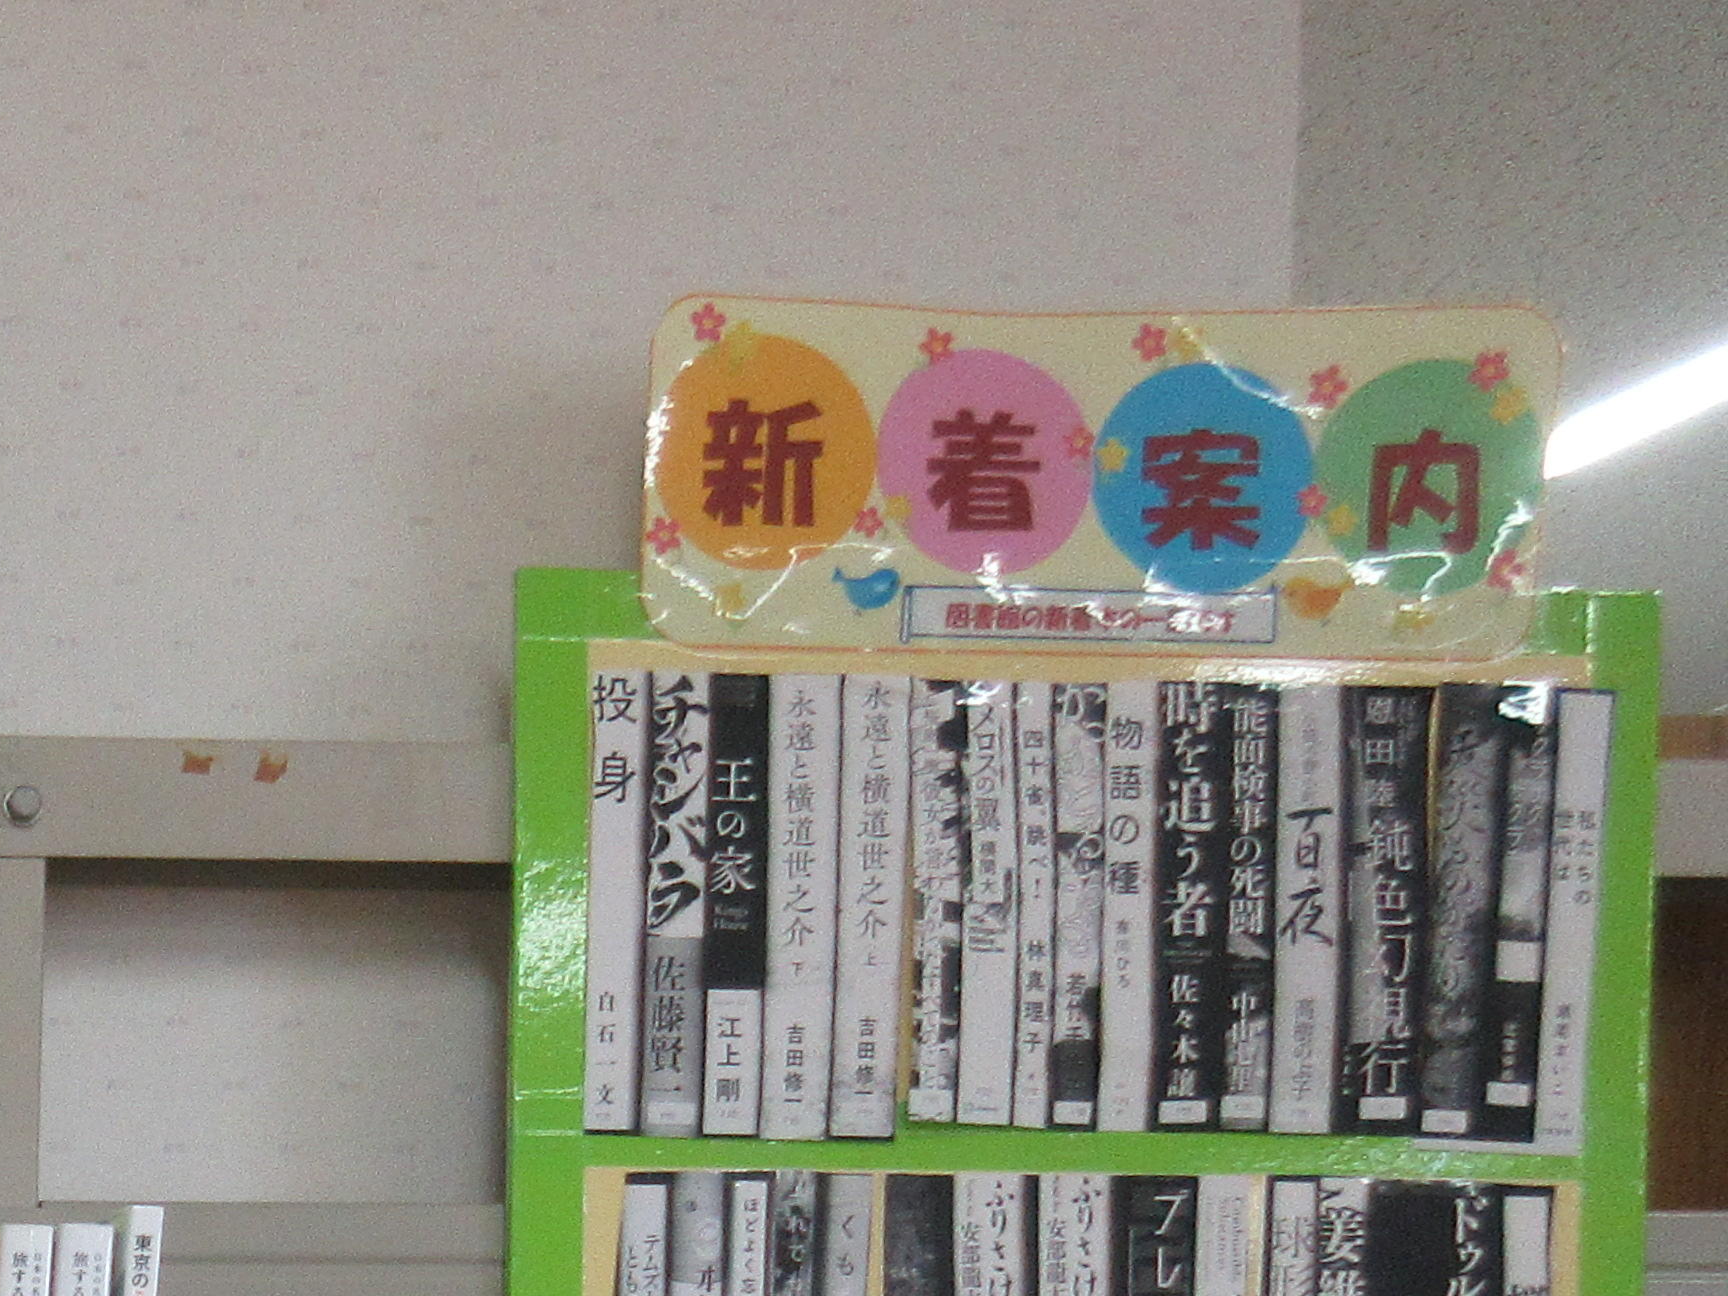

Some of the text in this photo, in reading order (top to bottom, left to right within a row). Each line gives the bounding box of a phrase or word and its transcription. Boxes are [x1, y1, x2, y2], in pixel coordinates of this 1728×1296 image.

[701, 397, 1482, 558] 新着案内
[594, 677, 636, 1104] 投身 白石一文
[648, 675, 708, 1095] チャンバラ 佐藤賢一
[712, 758, 756, 1100] 王の家 江上剛
[782, 690, 817, 1104] 永遠と横道世之介 吉田修一
[857, 686, 892, 1095] 永遠と横道世之介 吉田修一
[1108, 717, 1143, 896] 物語の種
[1160, 682, 1215, 1097] 時を追う者 佐々木譲
[1228, 699, 1267, 936] 能面検事の死闘
[1366, 820, 1416, 1093] 鈍色幻視行
[1023, 941, 1045, 1053] 林真理子
